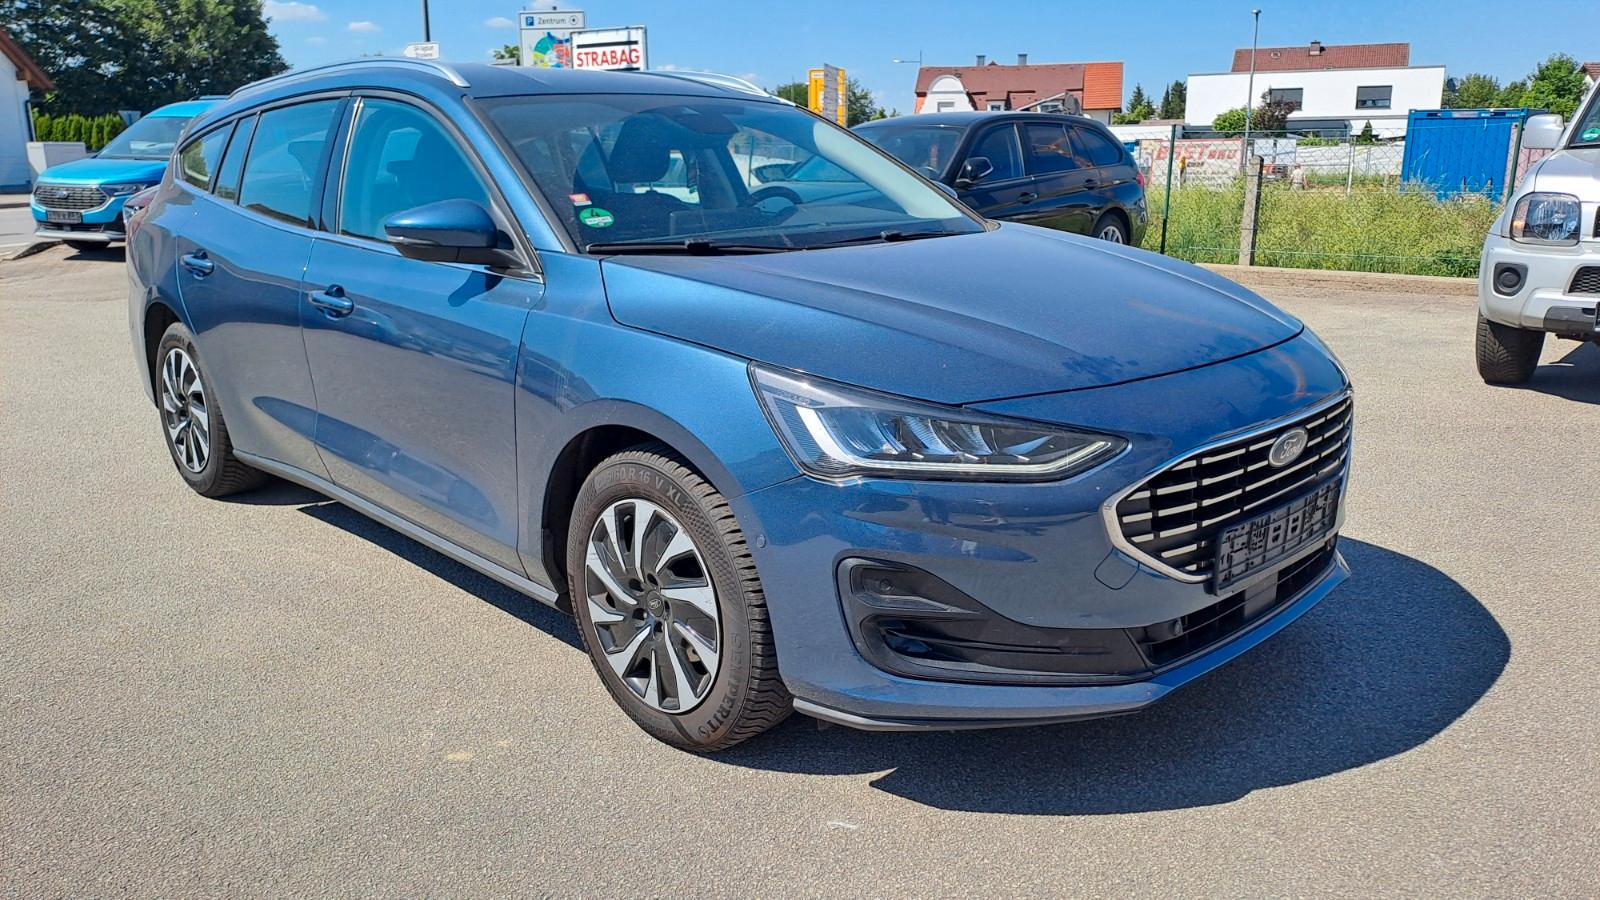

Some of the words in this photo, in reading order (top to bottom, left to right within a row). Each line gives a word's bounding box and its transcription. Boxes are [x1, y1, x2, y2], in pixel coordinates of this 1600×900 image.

[538, 17, 566, 25] Zentrum
[577, 48, 640, 67] STRABAG
[1280, 437, 1303, 459] Ford
[639, 470, 650, 485] 16
[655, 475, 664, 490] V
[667, 485, 682, 505] XL
